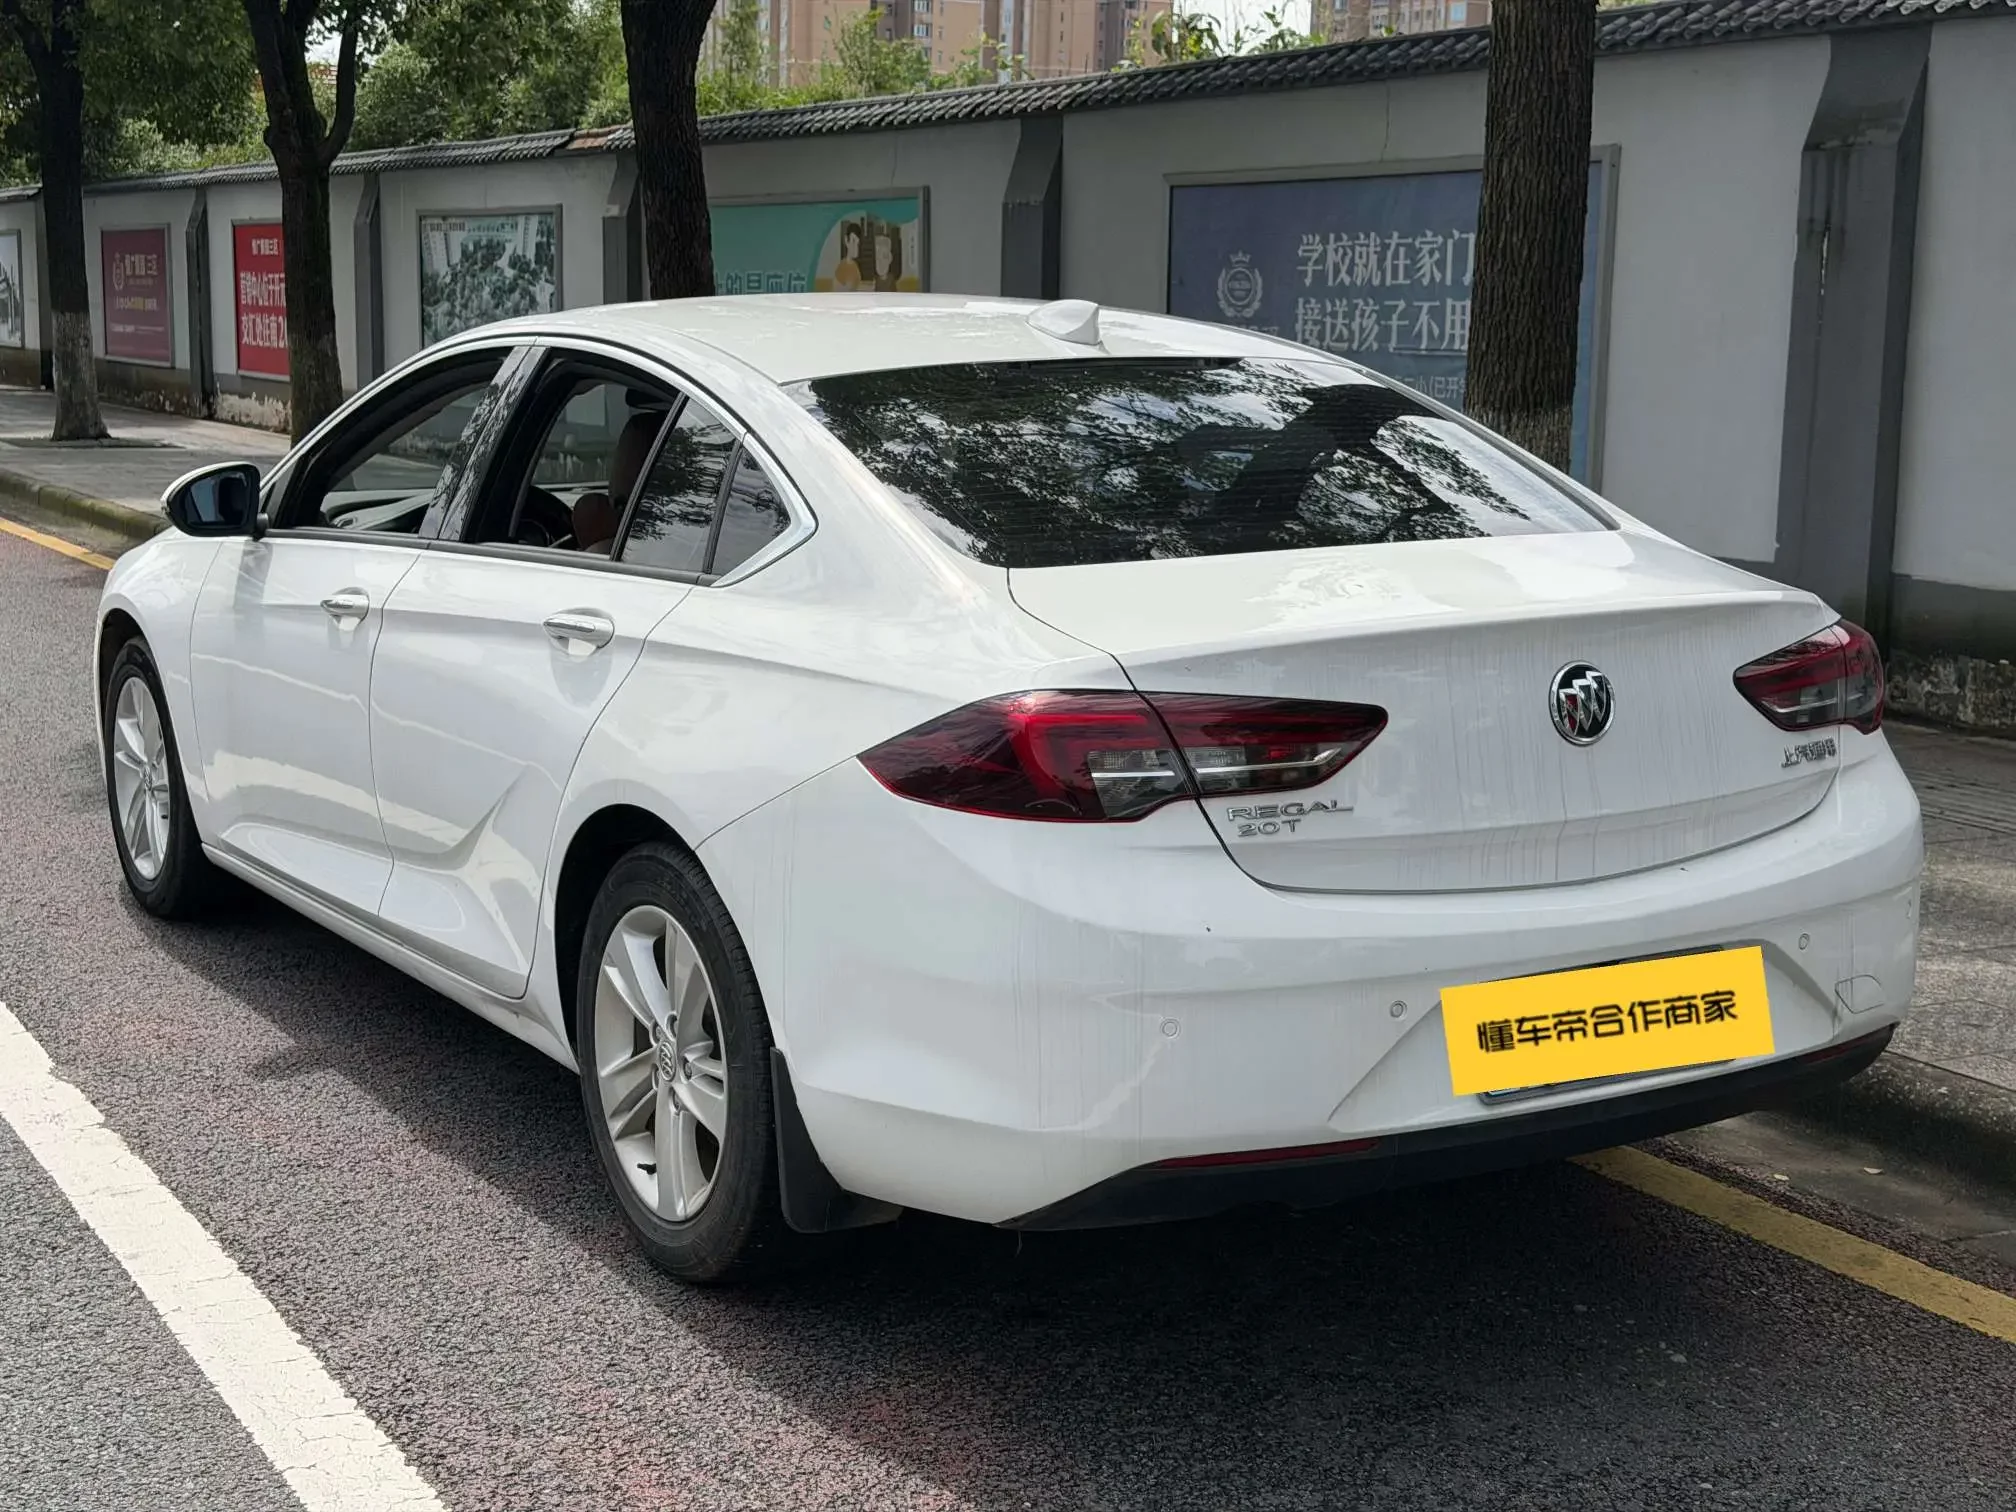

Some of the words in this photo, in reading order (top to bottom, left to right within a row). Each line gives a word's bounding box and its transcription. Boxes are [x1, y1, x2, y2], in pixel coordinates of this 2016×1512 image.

[1296, 229, 1475, 287] 学校就在家门
[1295, 297, 1469, 353] 接送孩子不用
[1226, 800, 1354, 822] REGAL
[1237, 819, 1302, 837] 20T
